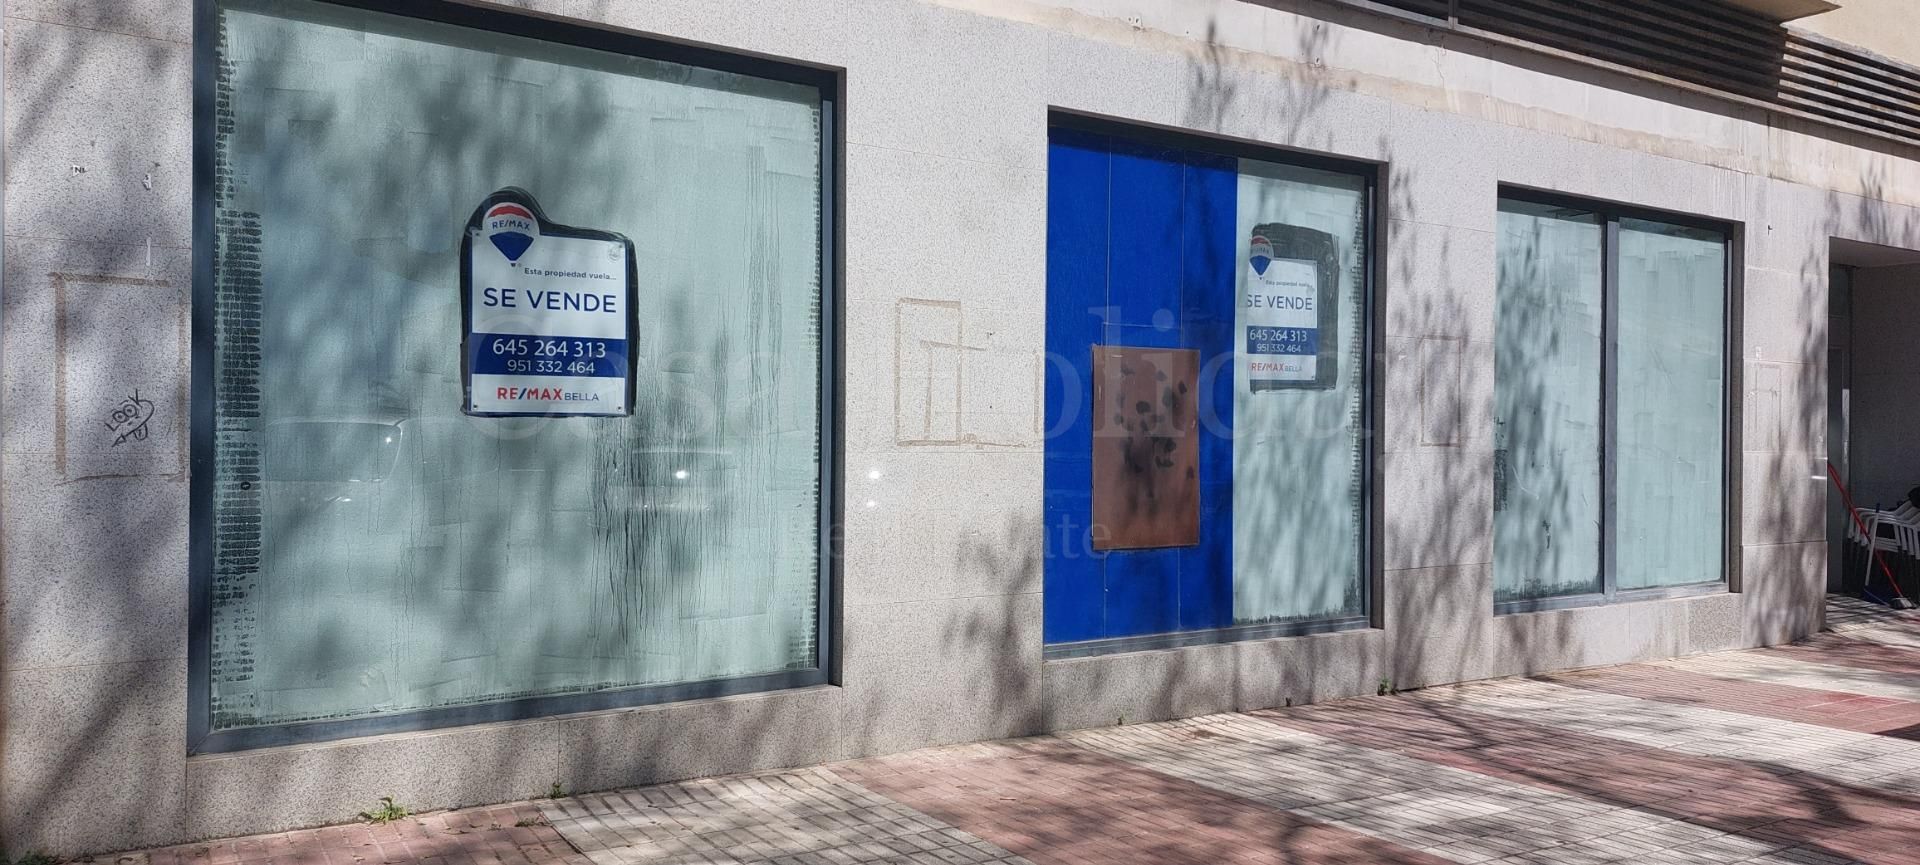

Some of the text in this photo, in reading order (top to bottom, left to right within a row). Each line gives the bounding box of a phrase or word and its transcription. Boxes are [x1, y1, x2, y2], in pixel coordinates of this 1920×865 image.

[492, 219, 530, 231] RE/MAX
[524, 267, 542, 276] Esta
[544, 268, 587, 279] propiedad
[483, 287, 617, 313] SE VENDE
[1248, 294, 1313, 311] SE VENDE
[1249, 329, 1307, 342] 645 264 313
[492, 338, 606, 358] 645 264 313
[1256, 343, 1301, 353] 951 332 464
[507, 359, 595, 374] 951 332 464
[1251, 362, 1284, 372] RE/MAX
[497, 387, 599, 401] RE/MAX BELLA
